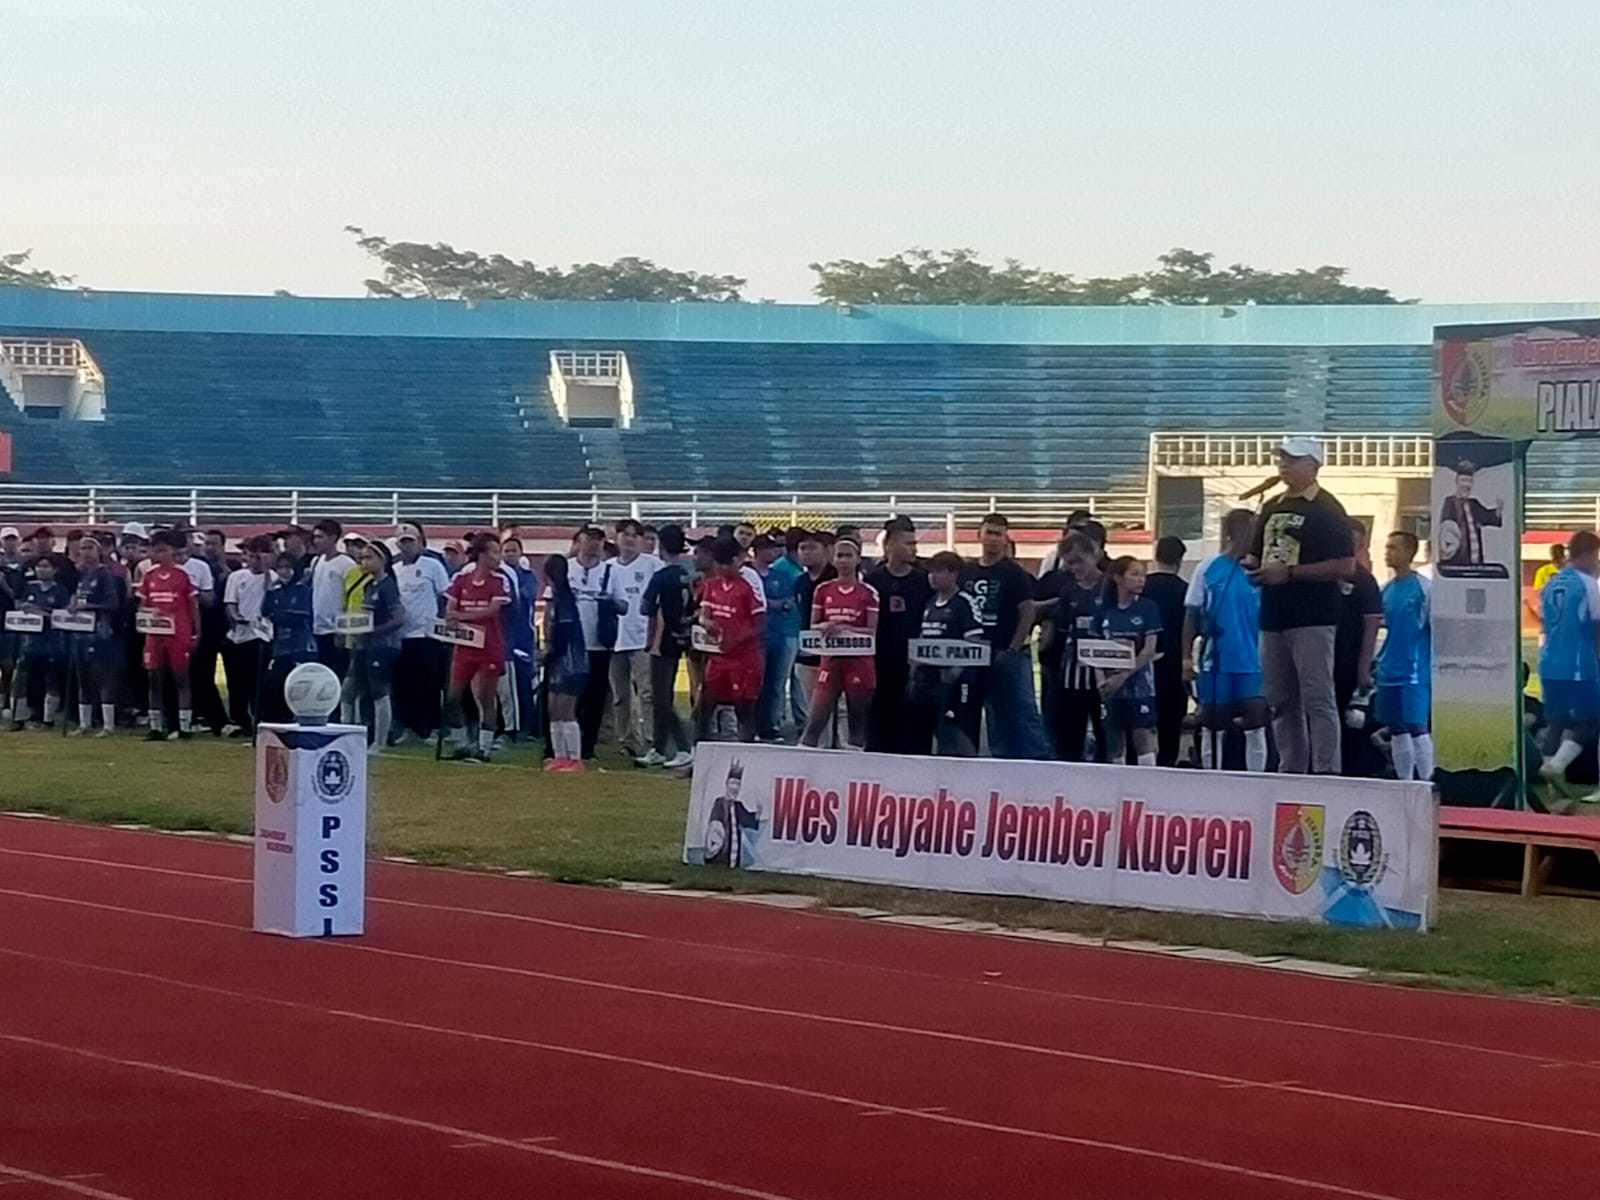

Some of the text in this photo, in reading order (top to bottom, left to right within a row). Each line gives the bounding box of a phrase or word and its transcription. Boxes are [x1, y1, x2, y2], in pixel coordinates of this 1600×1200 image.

[946, 646, 982, 659] PANTI
[772, 777, 839, 845] Wes
[846, 782, 976, 857] Wayahe
[982, 791, 1111, 868] Jember
[1117, 799, 1251, 880] Kueren
